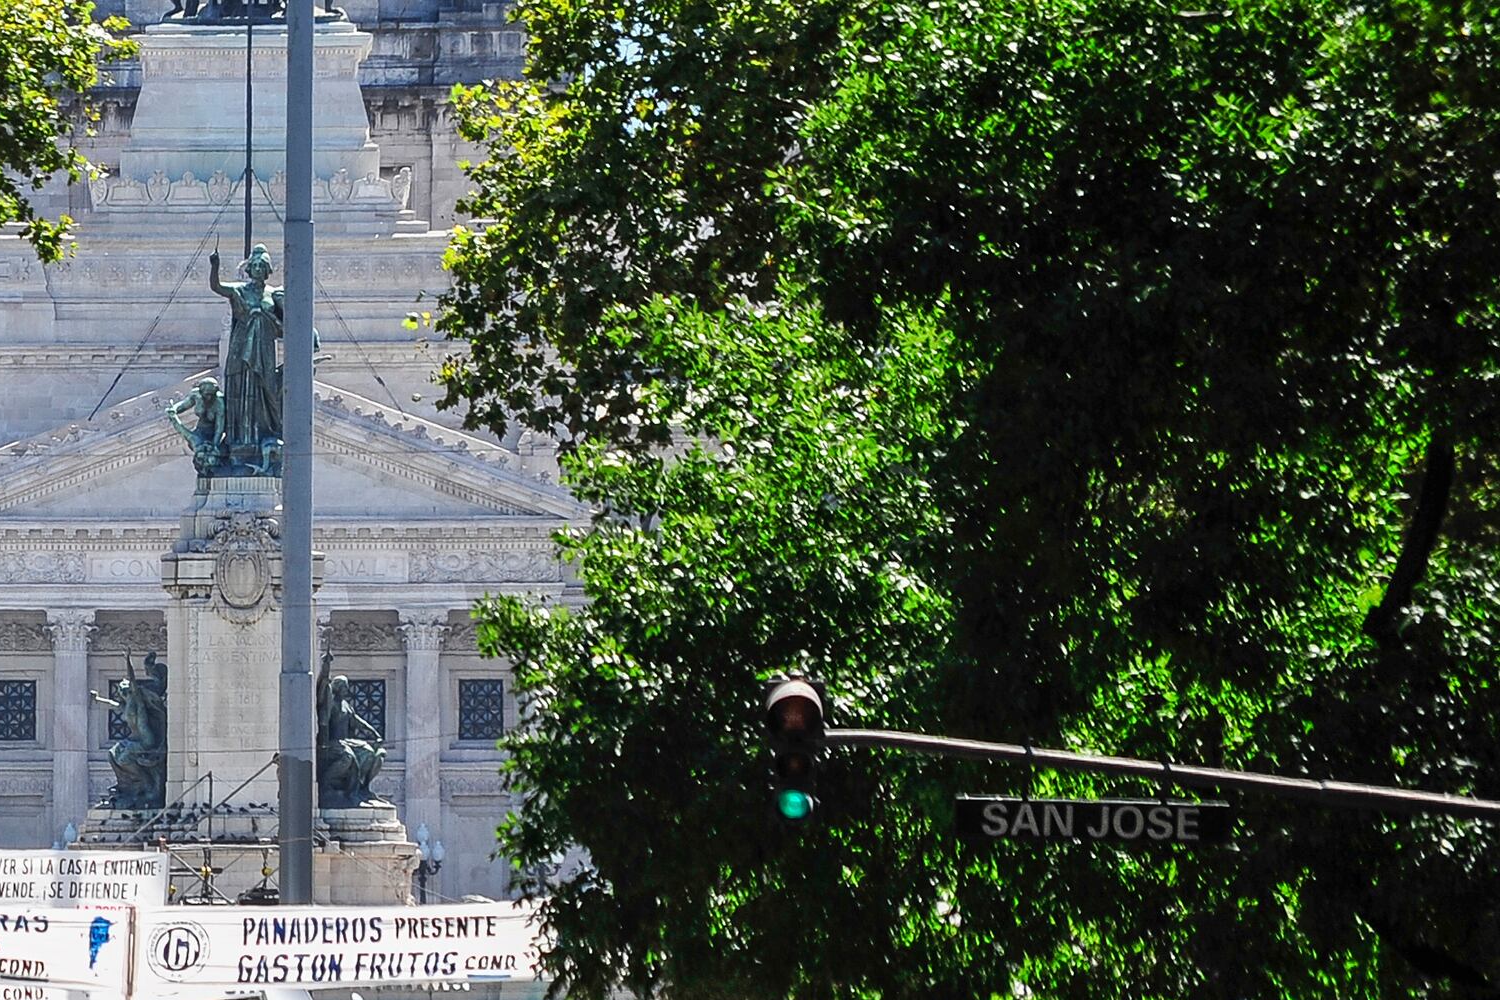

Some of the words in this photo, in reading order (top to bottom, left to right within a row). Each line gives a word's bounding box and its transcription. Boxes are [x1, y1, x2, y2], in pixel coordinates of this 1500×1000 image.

[981, 803, 1074, 837] SAN
[1087, 805, 1200, 841] JOSE
[22, 858, 33, 875] SI
[40, 858, 54, 875] LA
[59, 858, 97, 875] CASTA
[243, 916, 383, 946] PANADEROS
[394, 915, 497, 939] PRESENTE
[237, 953, 344, 983] GASTON
[354, 951, 459, 981] FRUTOS
